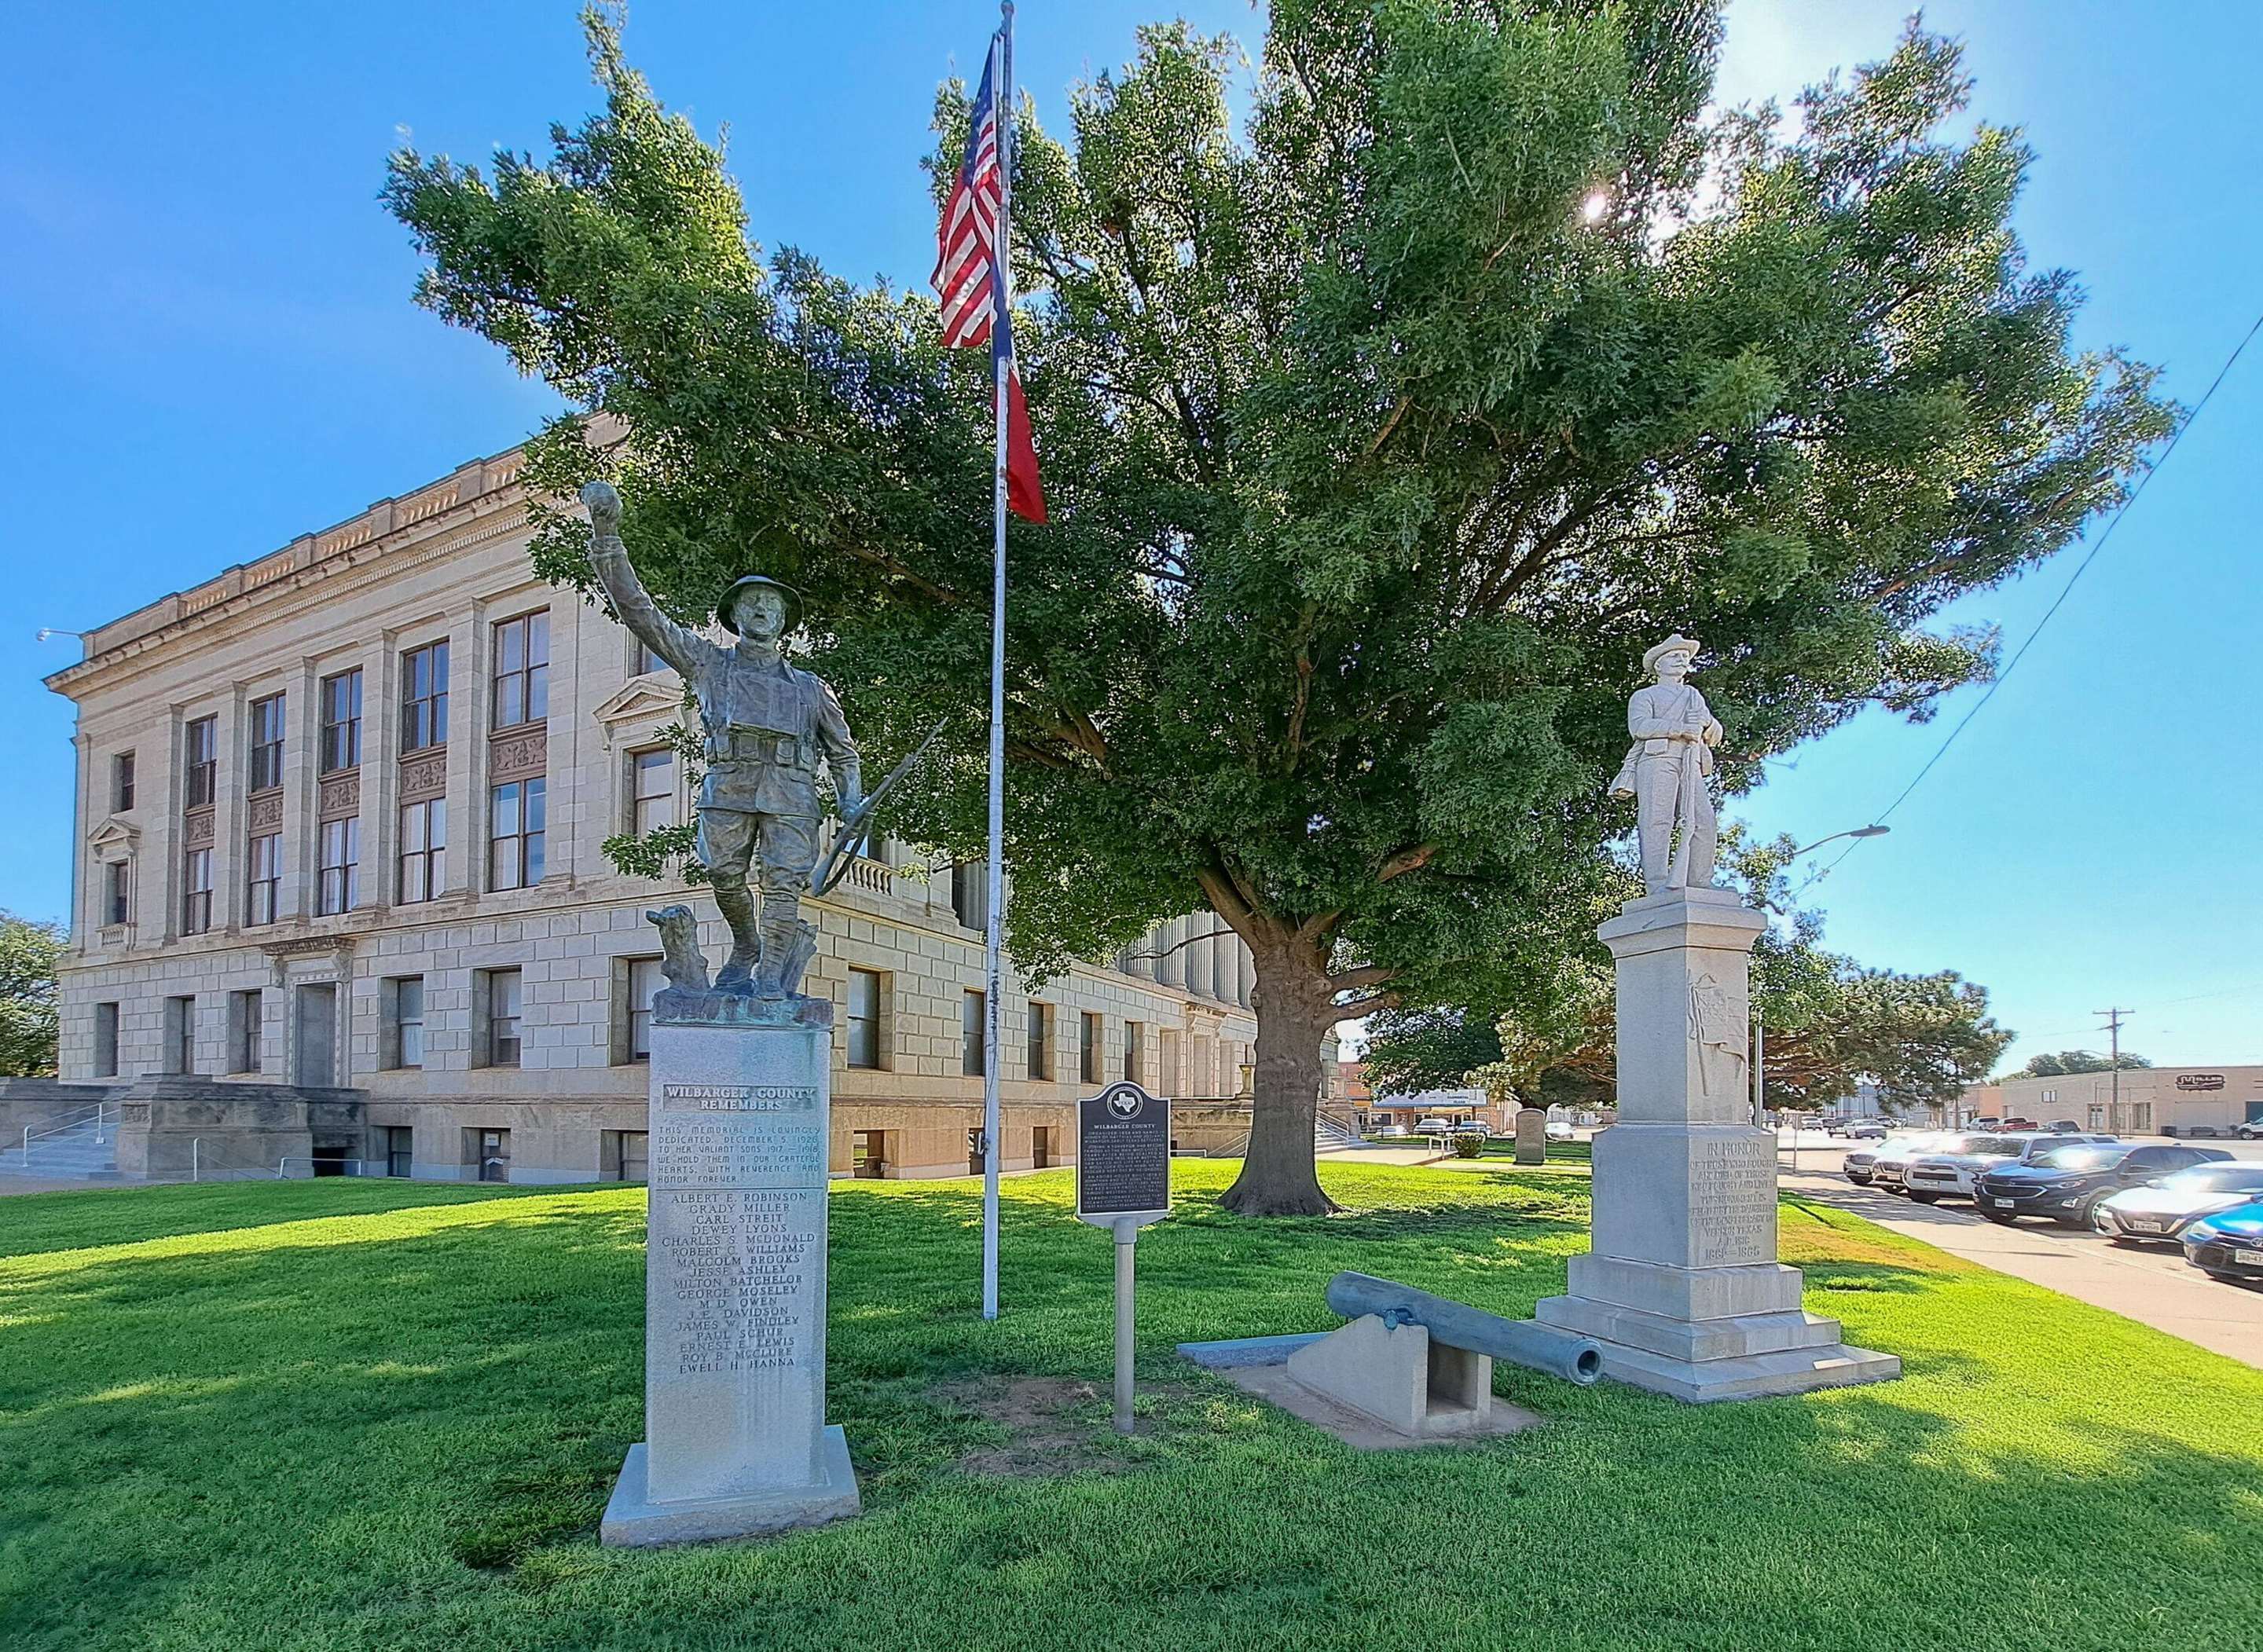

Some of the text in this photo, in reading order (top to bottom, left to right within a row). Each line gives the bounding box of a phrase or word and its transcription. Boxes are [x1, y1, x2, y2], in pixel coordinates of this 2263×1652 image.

[666, 1086, 816, 1099] WILBARGER COUNTY
[700, 1100, 781, 1110] REMEMBERS
[1707, 1142, 1760, 1157] IN HONOR
[672, 1194, 719, 1203] ALBERT
[743, 1192, 807, 1202] ROBINSON
[689, 1203, 790, 1214] GRADY MILLER
[696, 1214, 783, 1225] CARL STREIT
[691, 1224, 787, 1235] DEWEY LYONS
[662, 1236, 721, 1247] CHARLES
[673, 1247, 720, 1257] ROBERT
[746, 1244, 805, 1254] WILLIAMS
[677, 1254, 800, 1267] MALCOLM BROOKS
[689, 1265, 787, 1277] JESSE ASHLEY
[673, 1275, 802, 1288] MILTON BATCHELOR
[677, 1285, 798, 1299] GEORGE MOSELEY
[739, 1297, 777, 1307] OWEN
[724, 1306, 788, 1319] DAVIDSON
[675, 1321, 718, 1331] JAMES
[748, 1316, 799, 1327] FINDLEY
[697, 1328, 783, 1341] PAUL SCHUR
[680, 1340, 731, 1353] ERNEST
[757, 1337, 794, 1347] LEWIS
[682, 1353, 707, 1363] ROY
[680, 1363, 722, 1374] EWELL
[750, 1358, 794, 1368] HANNA
